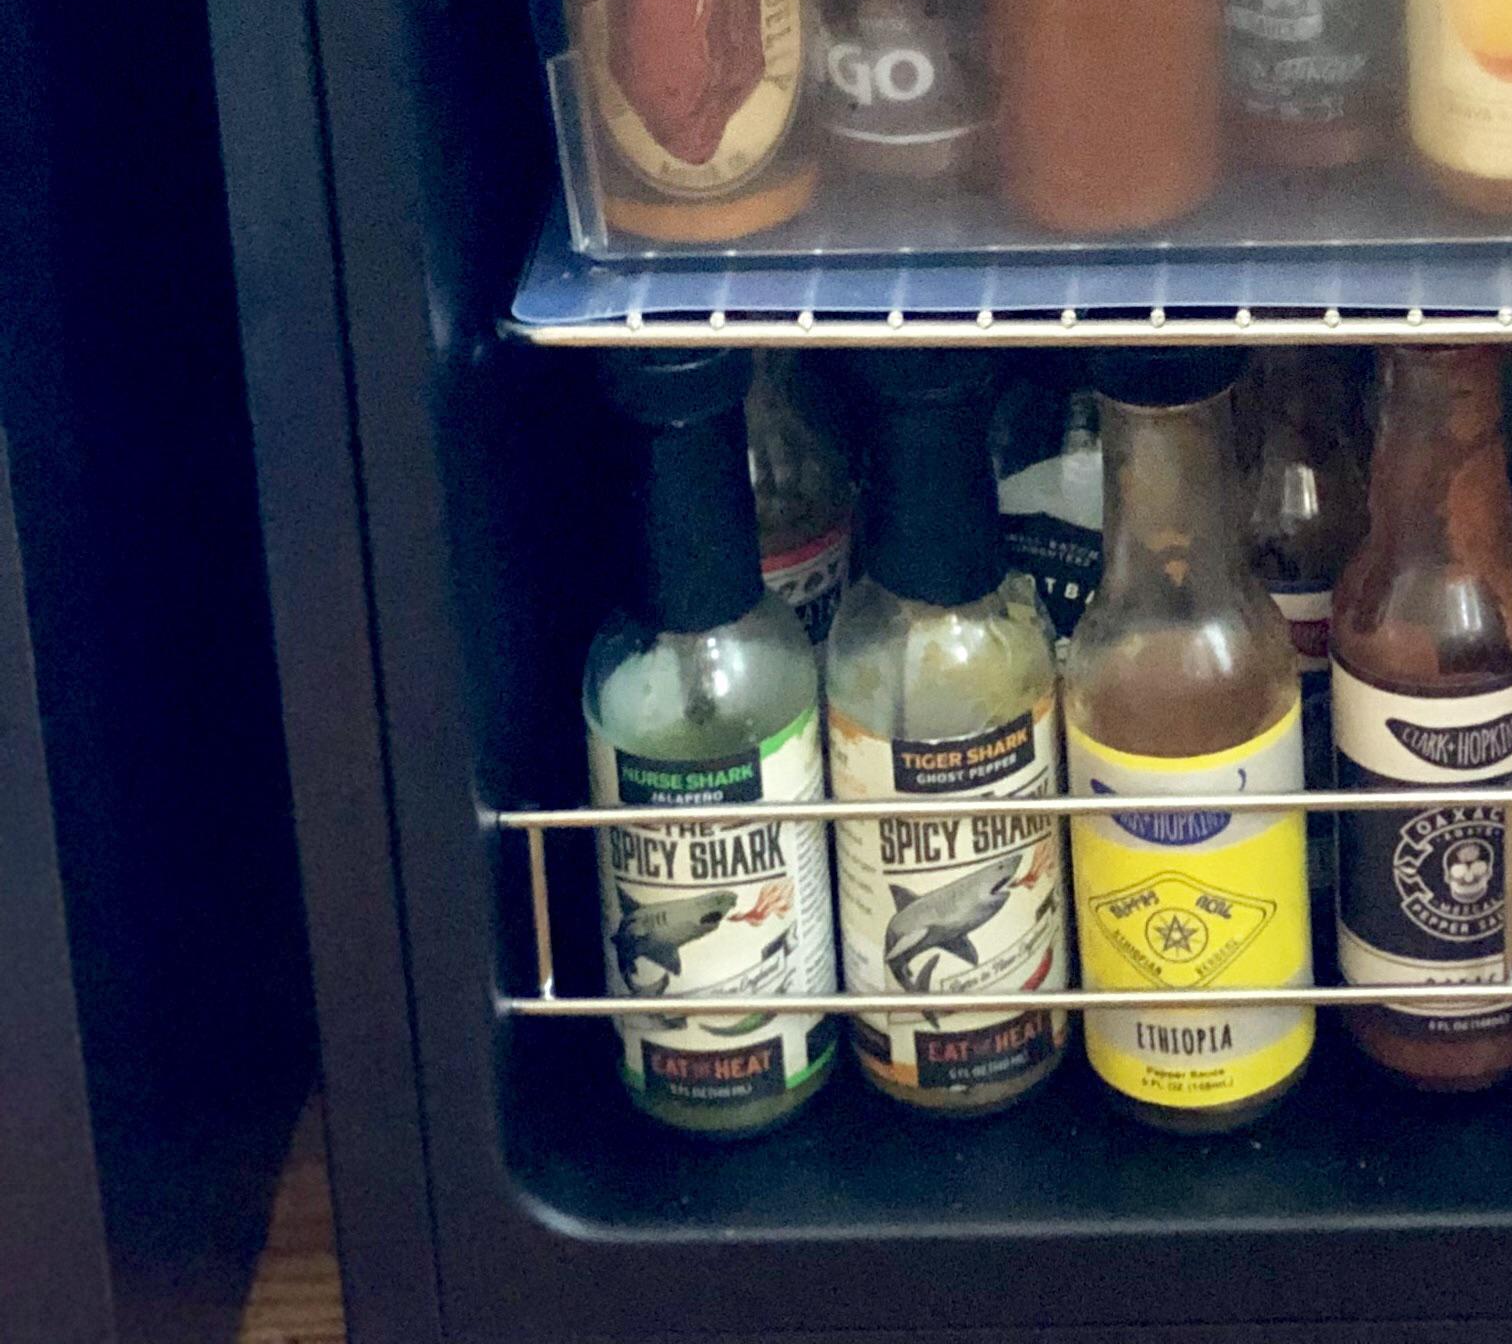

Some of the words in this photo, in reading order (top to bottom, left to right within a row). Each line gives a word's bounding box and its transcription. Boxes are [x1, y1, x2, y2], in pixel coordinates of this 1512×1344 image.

[902, 748, 962, 771] TIGER
[965, 730, 1029, 762] SHARK
[916, 767, 965, 785] GHOST
[968, 753, 1018, 780] PEPPER
[686, 764, 755, 789] SHARK
[609, 824, 677, 880] SPICY
[689, 822, 786, 880] SHARK
[879, 816, 960, 865] SPICY
[994, 1016, 1043, 1053] HEAT
[1136, 1020, 1234, 1057] ETHIOPIA
[714, 1051, 771, 1080] HEAT
